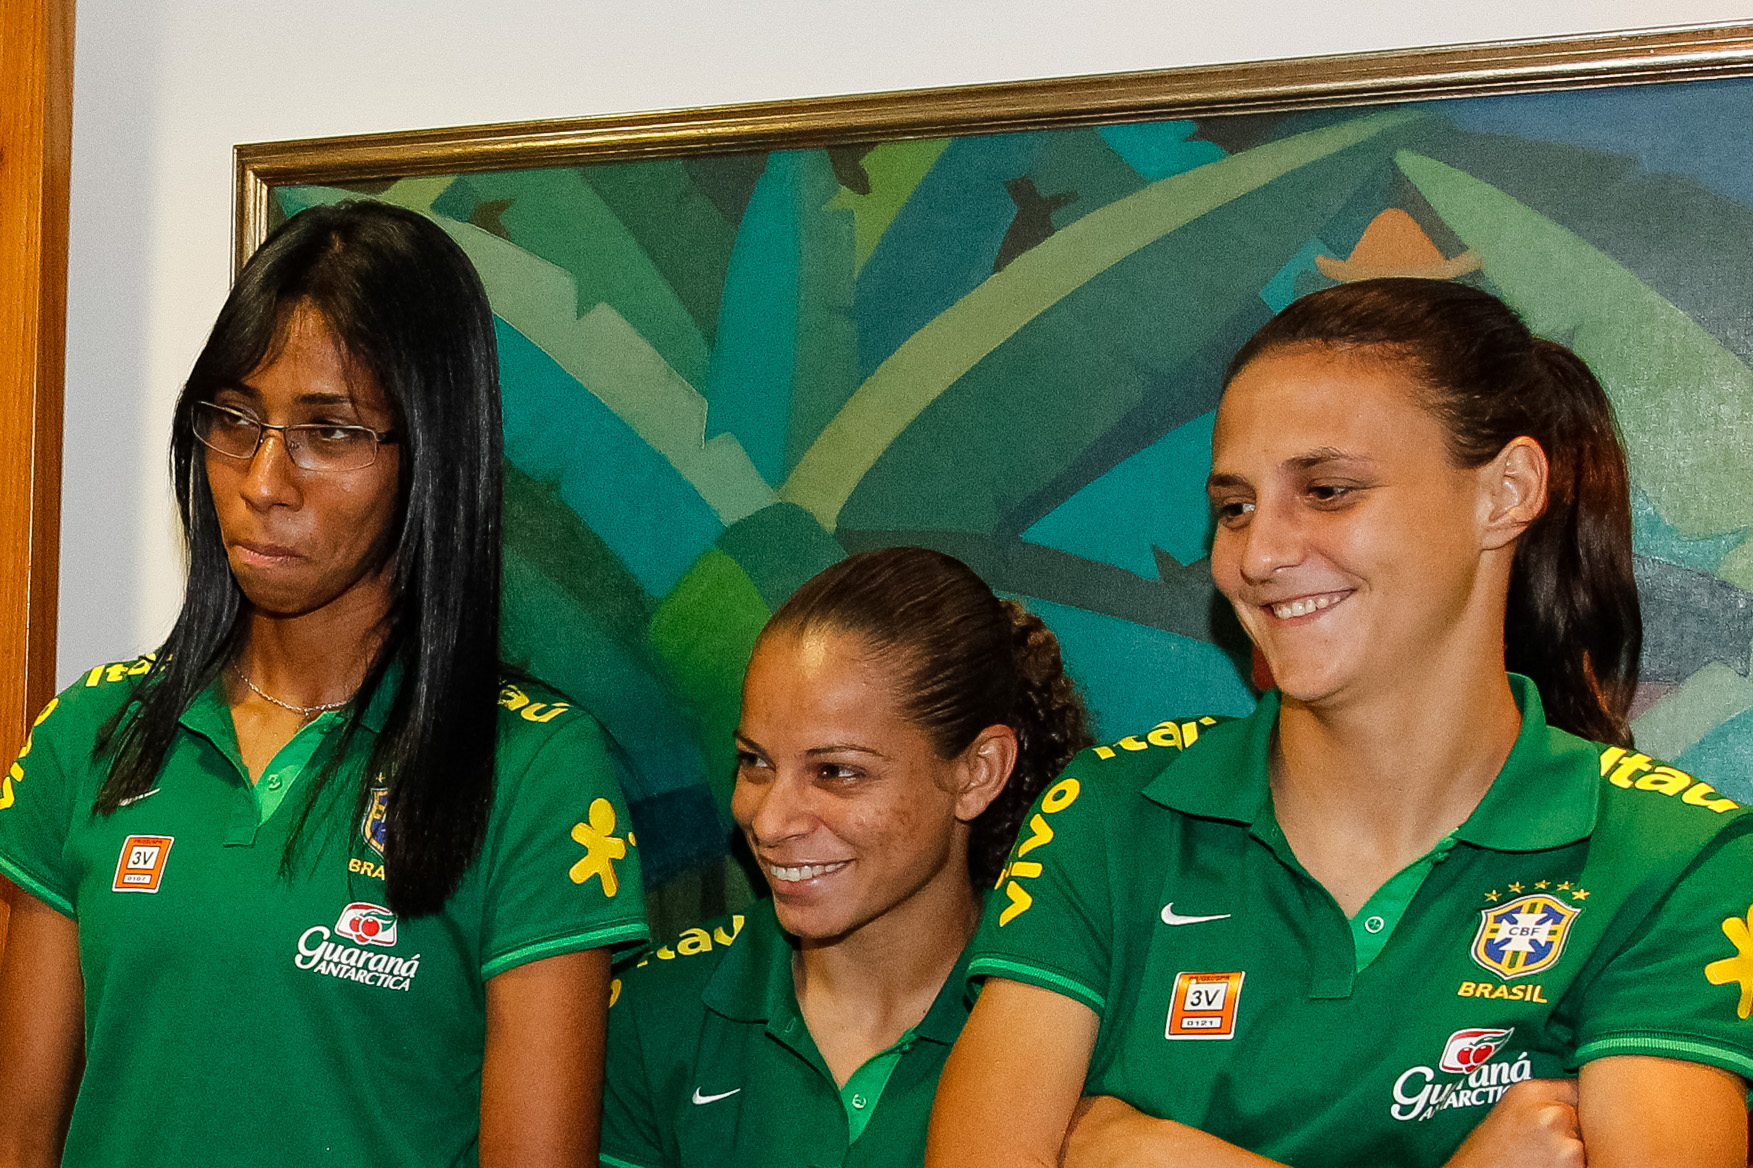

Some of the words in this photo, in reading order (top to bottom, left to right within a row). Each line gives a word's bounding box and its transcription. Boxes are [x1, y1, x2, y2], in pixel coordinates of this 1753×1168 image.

[85, 653, 157, 687] Ita
[132, 851, 154, 865] 3V
[996, 778, 1081, 927] vivo
[1508, 925, 1541, 938] CBF
[294, 925, 421, 979] Guaraná
[313, 960, 411, 992] ANTARCTICA
[1190, 989, 1221, 1007] 3V
[1457, 981, 1548, 1004] BRASIL
